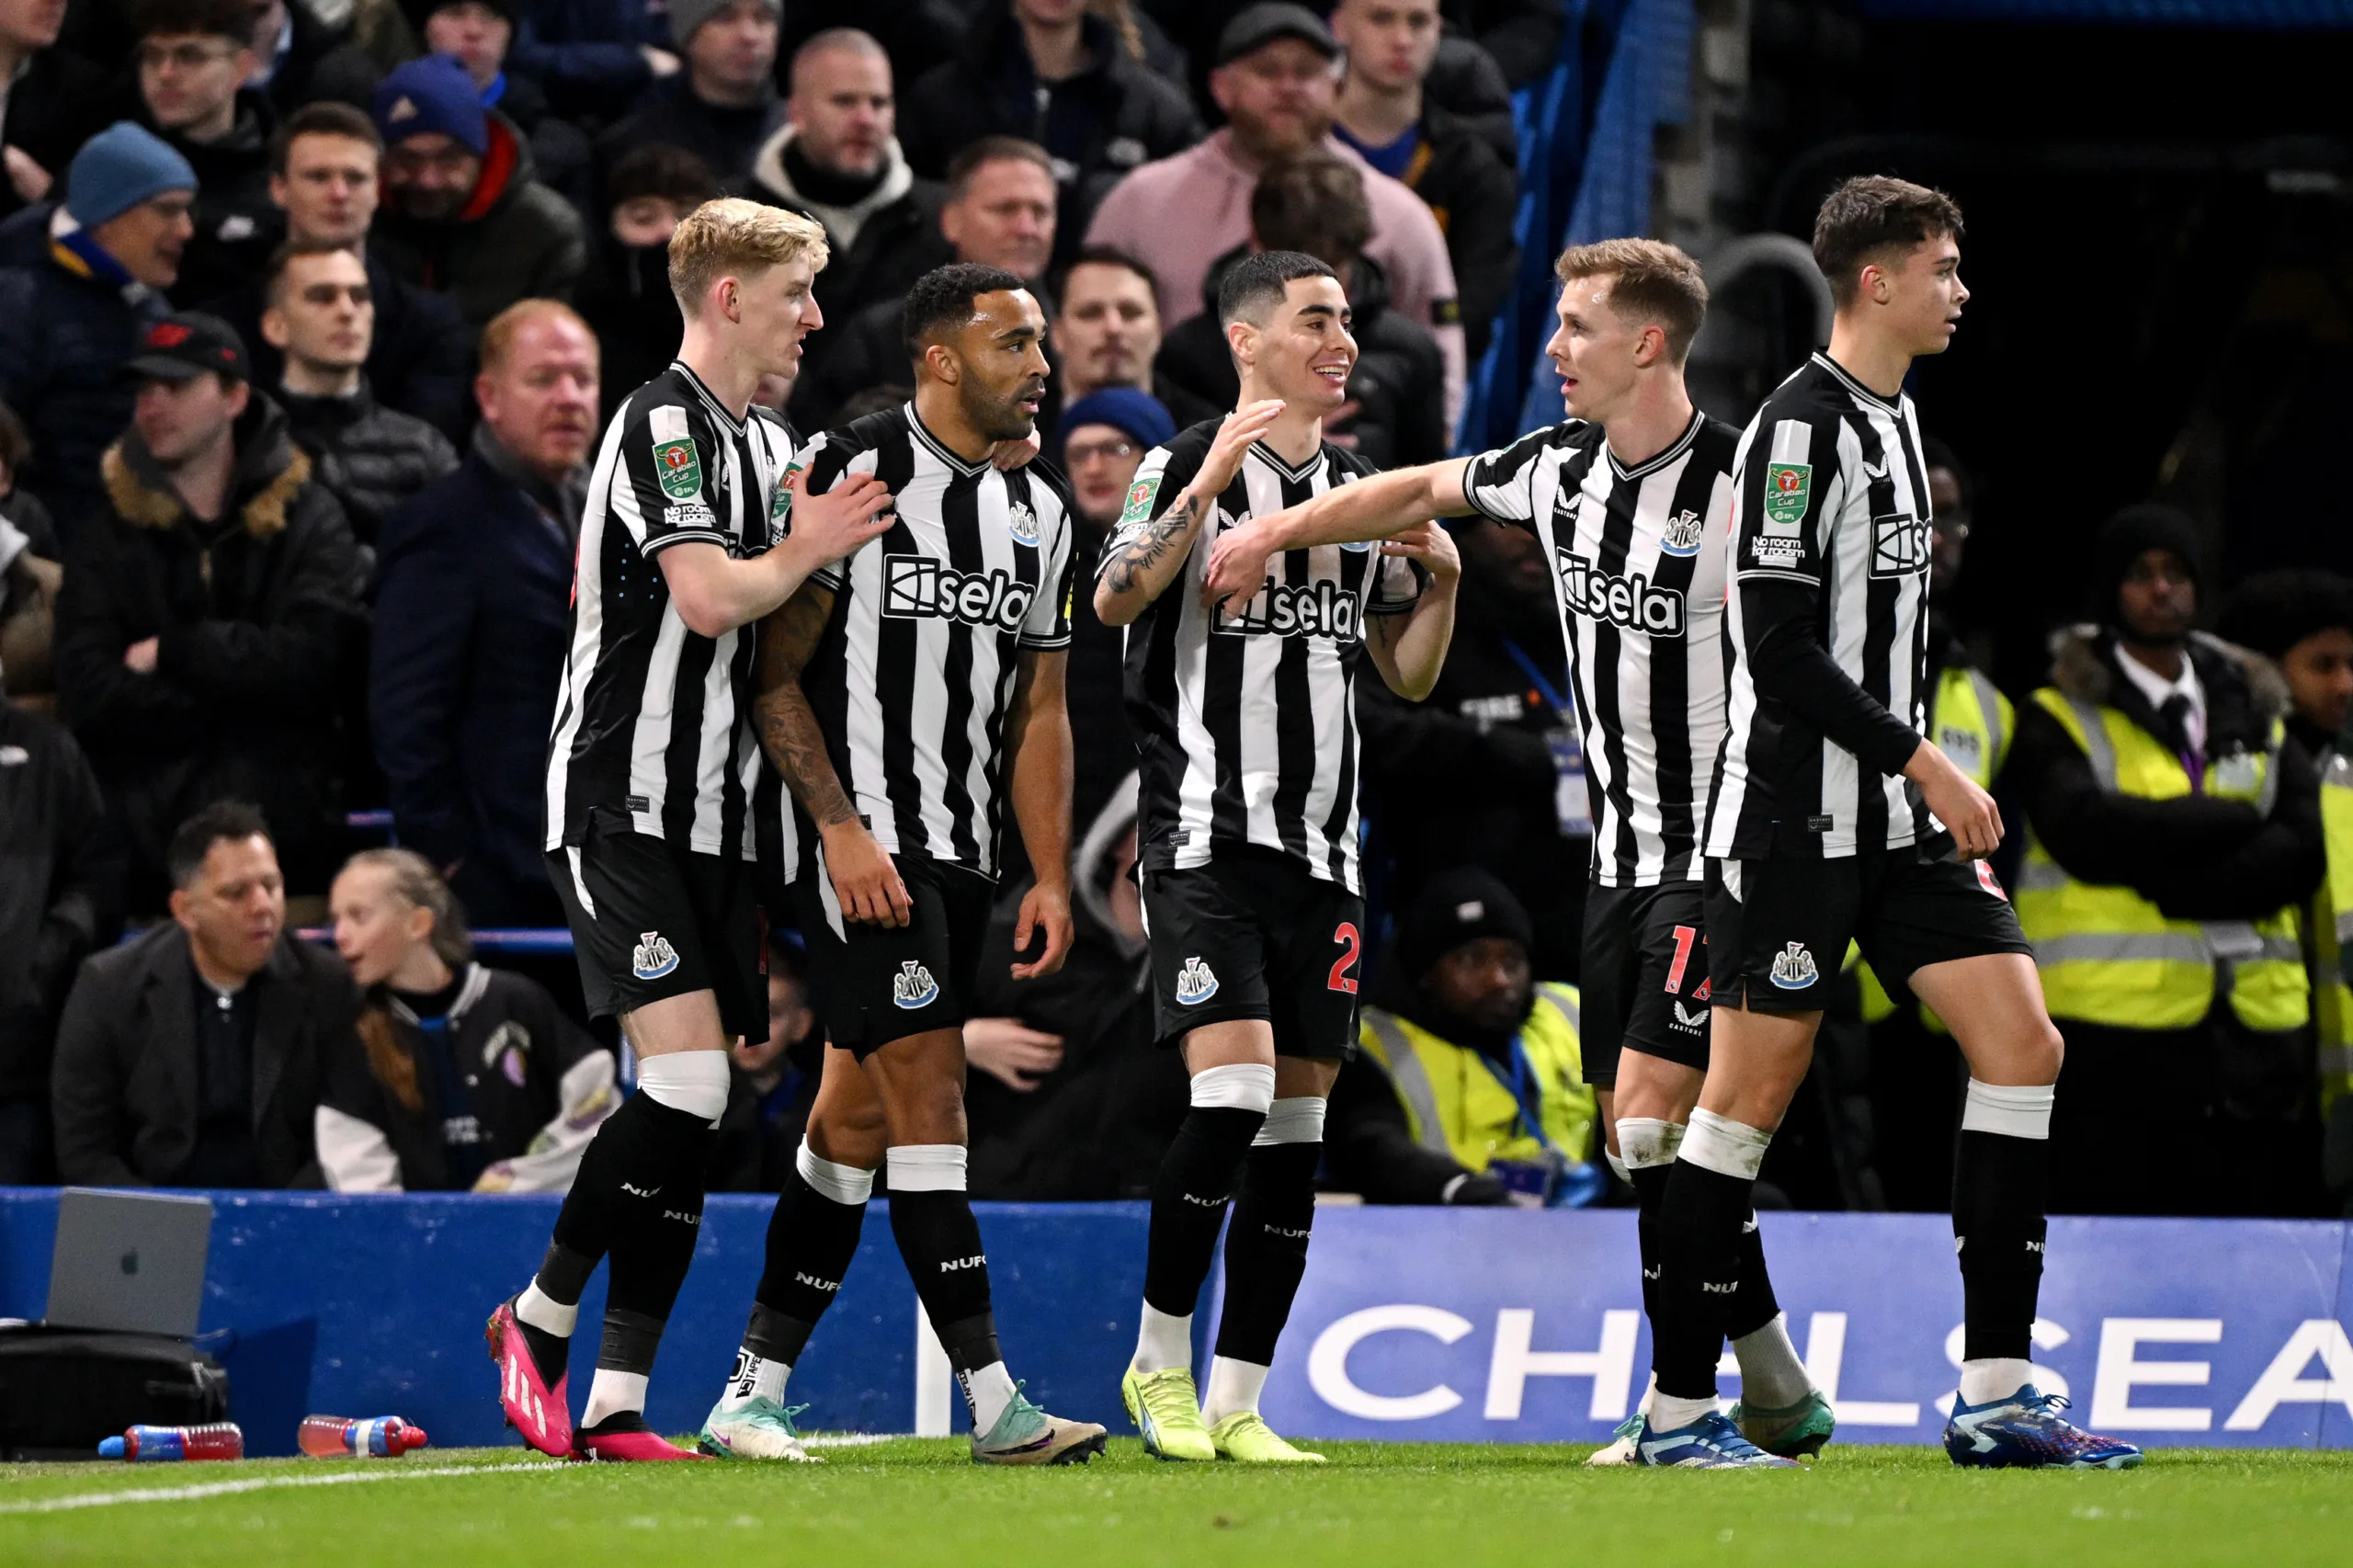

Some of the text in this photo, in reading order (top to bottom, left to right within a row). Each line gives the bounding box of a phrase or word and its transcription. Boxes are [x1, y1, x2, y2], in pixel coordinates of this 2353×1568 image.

[662, 460, 697, 480] Carabao
[672, 472, 689, 483] Cup
[1768, 489, 1806, 499] Carabao
[1778, 498, 1794, 506] Cup
[664, 505, 711, 516] No room
[1554, 507, 1578, 520] CASTORE
[665, 514, 717, 524] for racism
[1752, 536, 1801, 549] No room
[1751, 546, 1806, 558] for racism
[939, 574, 1031, 626] sela
[1589, 576, 1677, 630] sela
[1271, 585, 1354, 635] sela
[1327, 922, 1360, 994] 2
[1669, 1022, 1702, 1037] CASTORE
[1306, 1304, 2353, 1431] CHLEA
